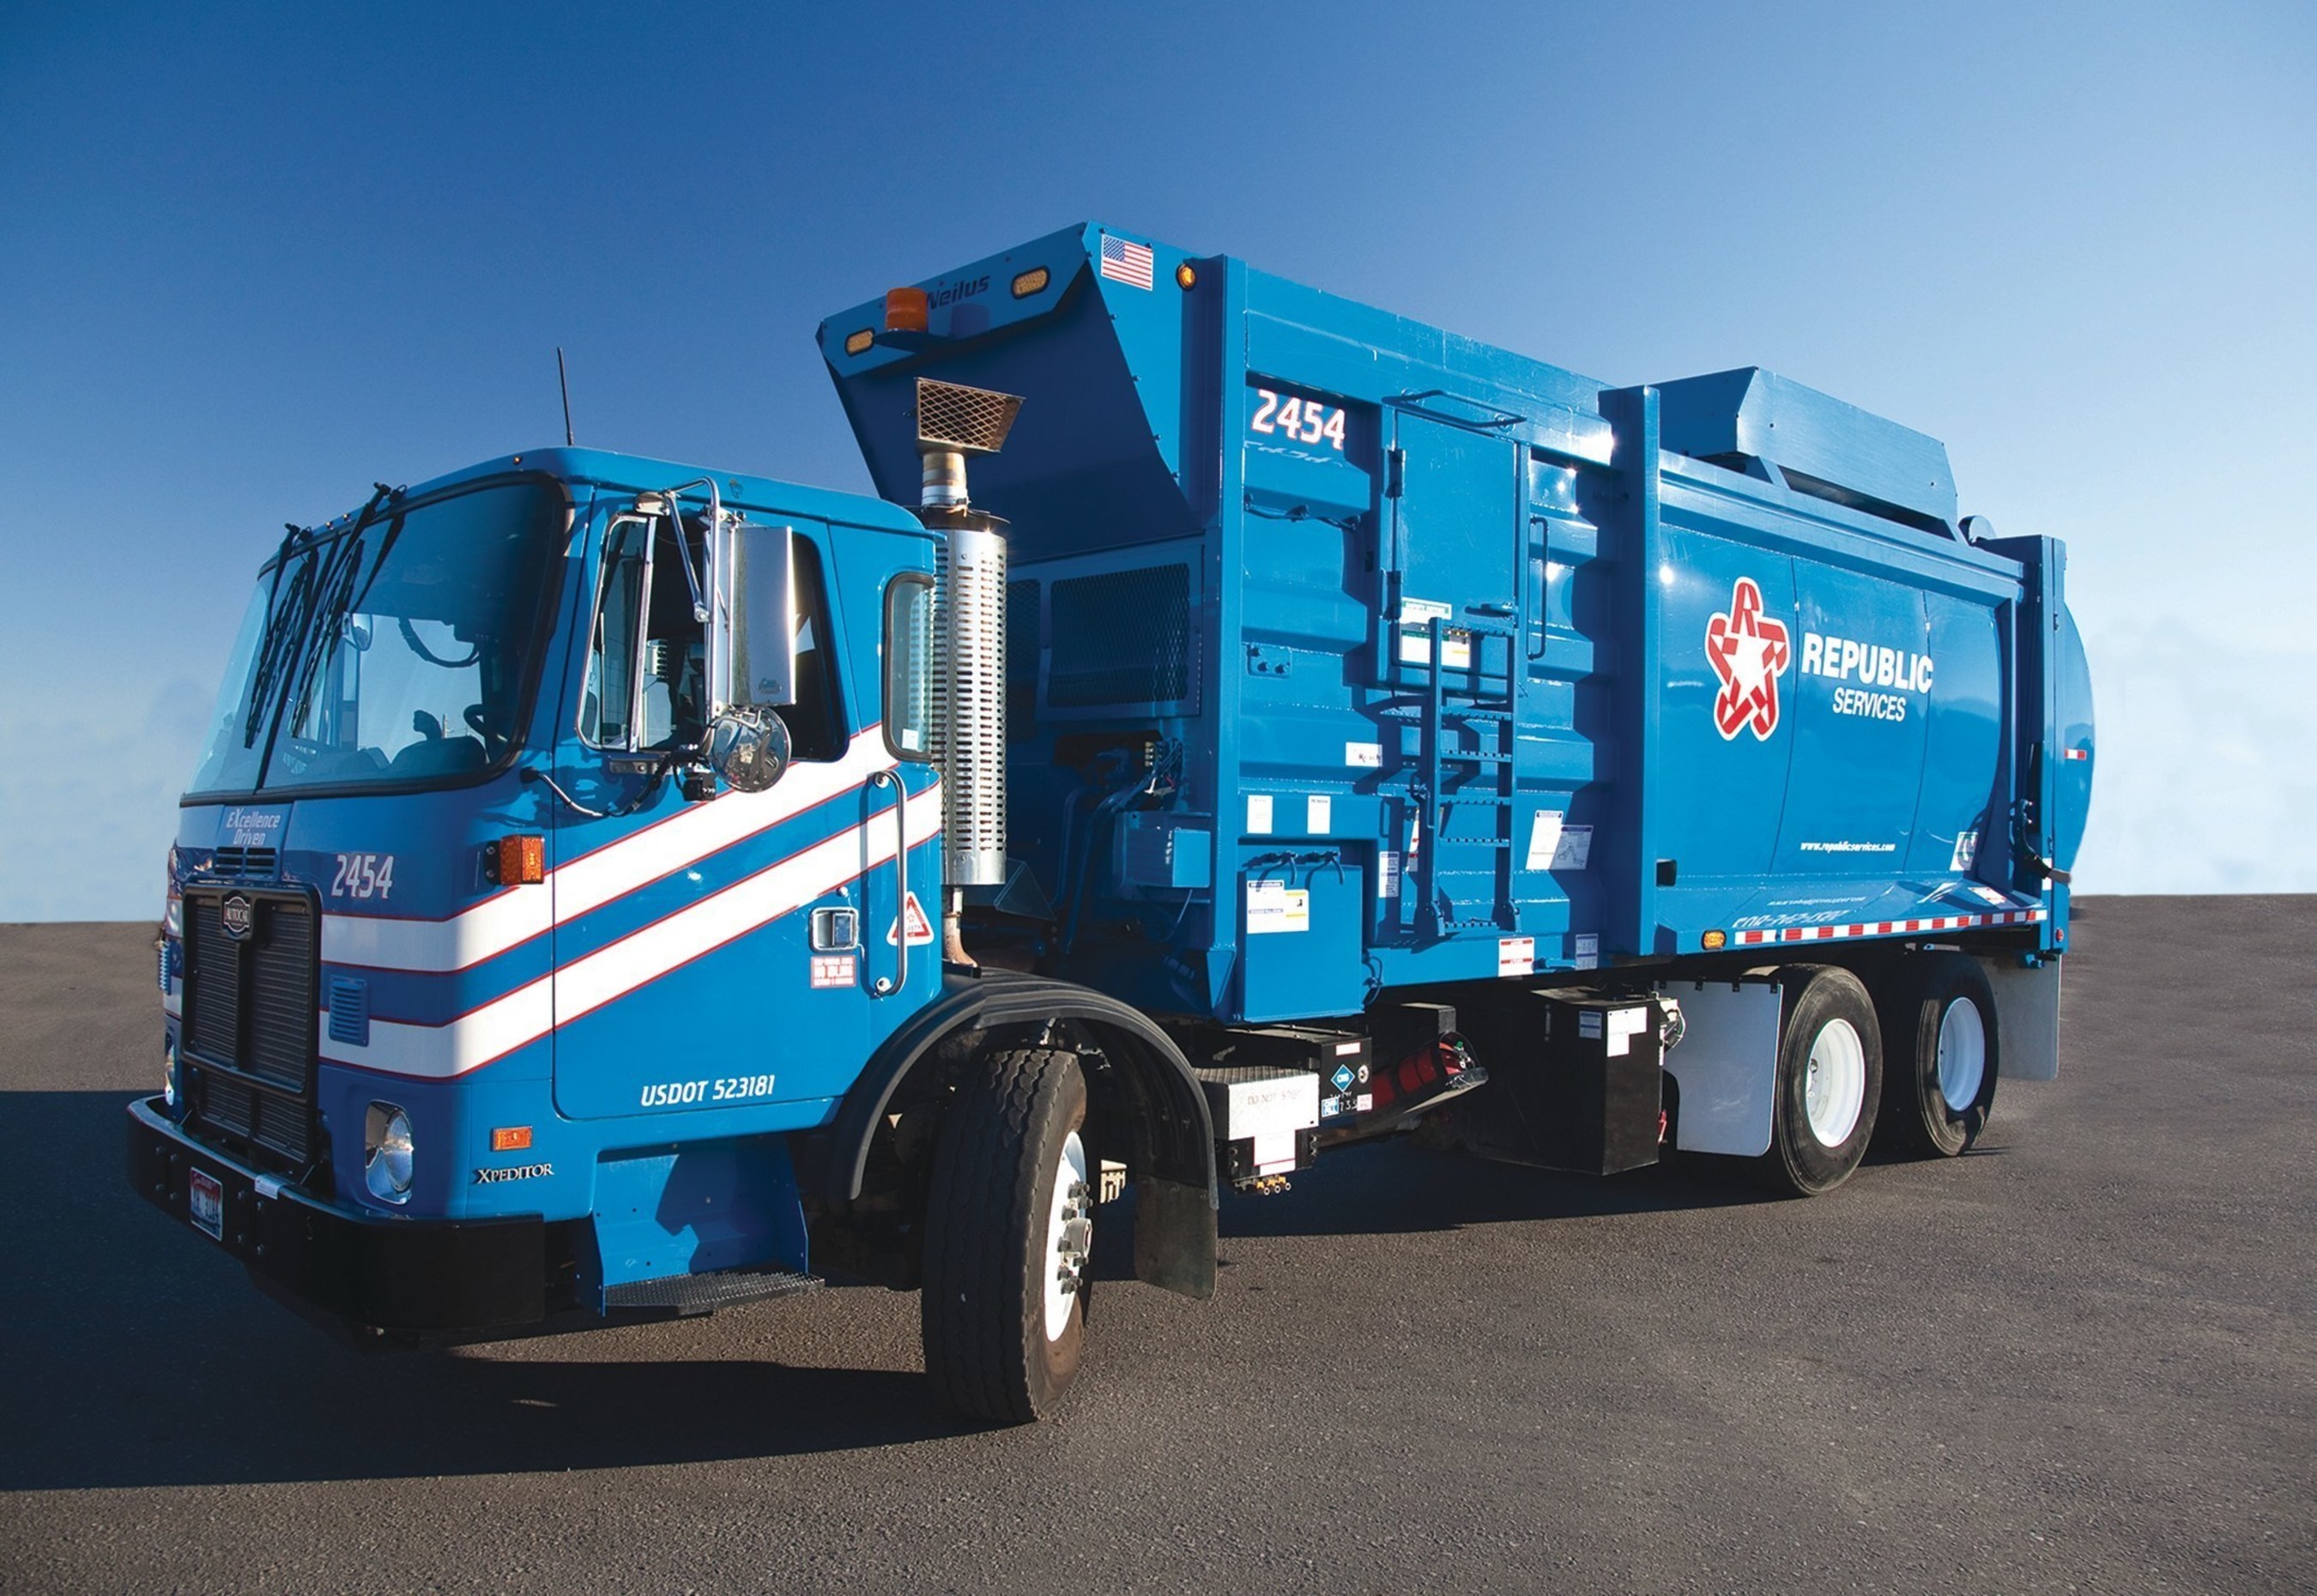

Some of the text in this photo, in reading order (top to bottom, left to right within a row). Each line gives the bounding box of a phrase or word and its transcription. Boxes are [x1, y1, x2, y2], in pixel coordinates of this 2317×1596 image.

[1251, 388, 1346, 451] 2454
[1801, 632, 1934, 694] REPUBLIC
[1832, 686, 1906, 722] SERVICES
[233, 828, 267, 846] Driven
[1800, 841, 1896, 853] www.republicservices.com
[331, 854, 395, 900] 2454
[641, 1074, 776, 1107] USDOT 523181
[476, 1163, 555, 1184] XPEDITOR
